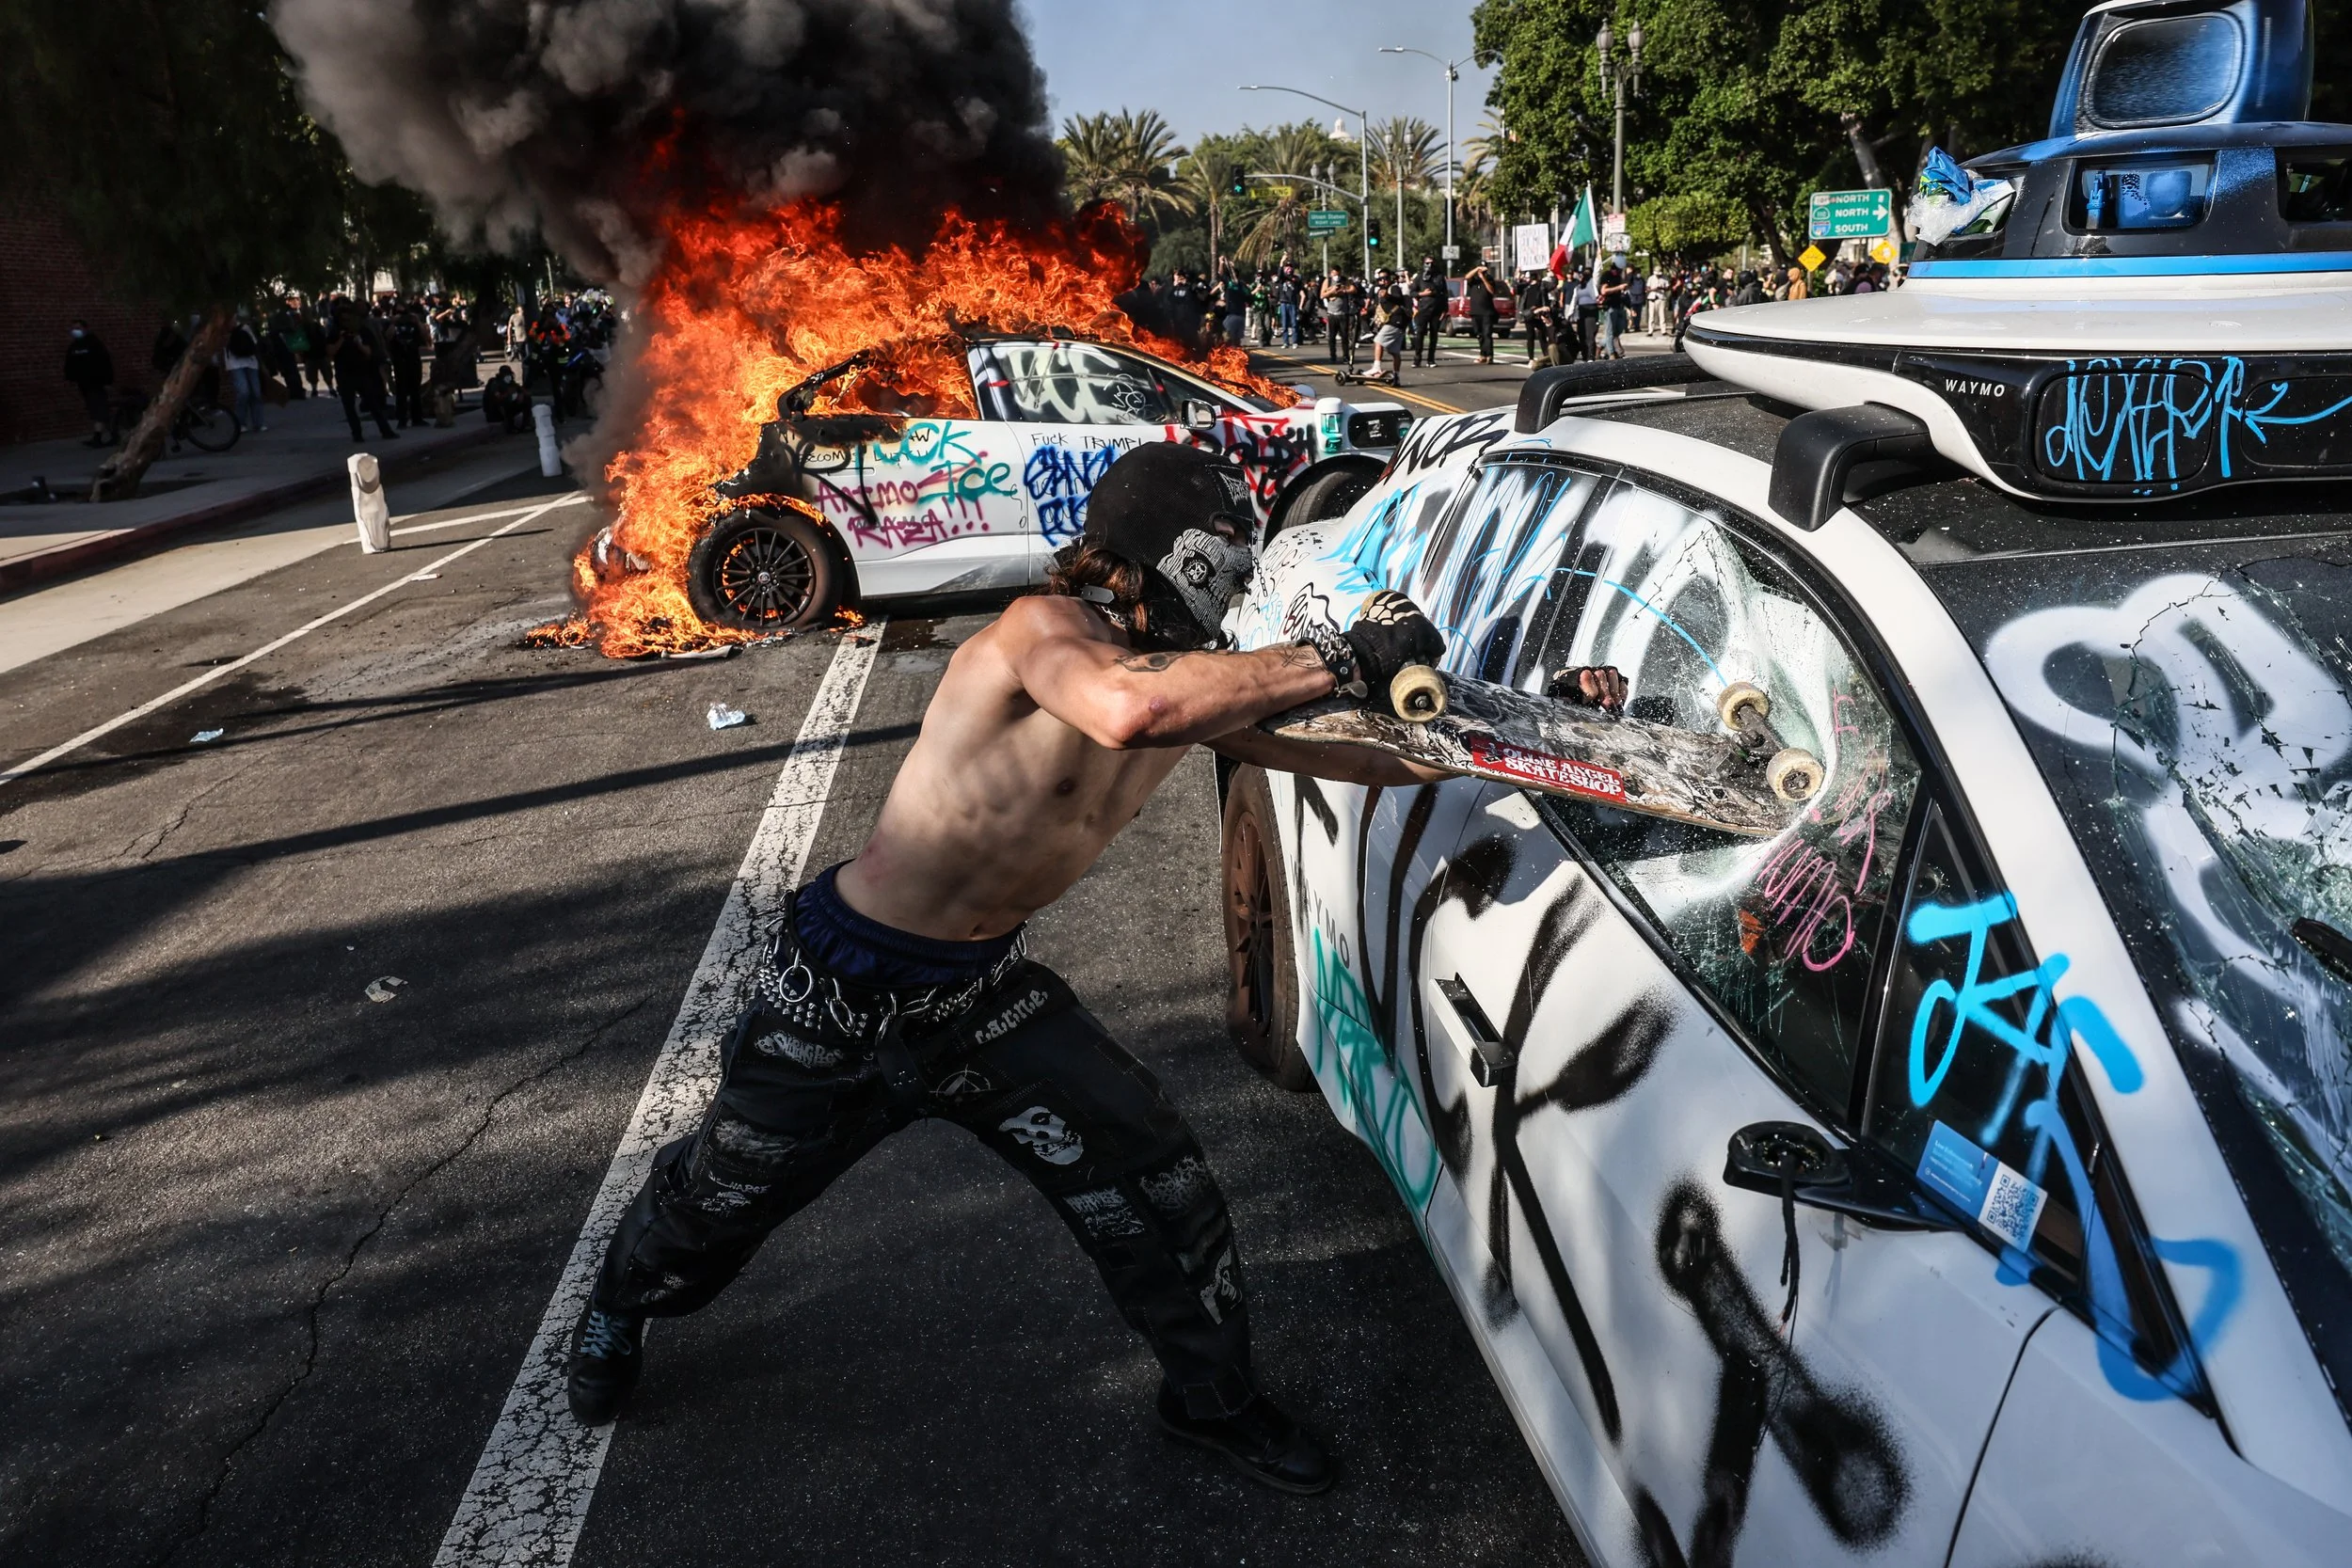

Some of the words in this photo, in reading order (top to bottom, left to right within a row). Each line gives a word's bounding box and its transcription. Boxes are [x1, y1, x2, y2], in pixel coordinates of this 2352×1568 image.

[1836, 194, 1869, 204] NORTH
[1835, 208, 1868, 217] NORTH
[1835, 224, 1868, 233] SOUTH
[1945, 378, 2007, 398] WAYMO
[1031, 433, 1069, 447] FUCK
[1502, 748, 1558, 769] OLLIE
[1561, 763, 1620, 785] ANGEL
[1504, 757, 1622, 796] SKATESHOP
